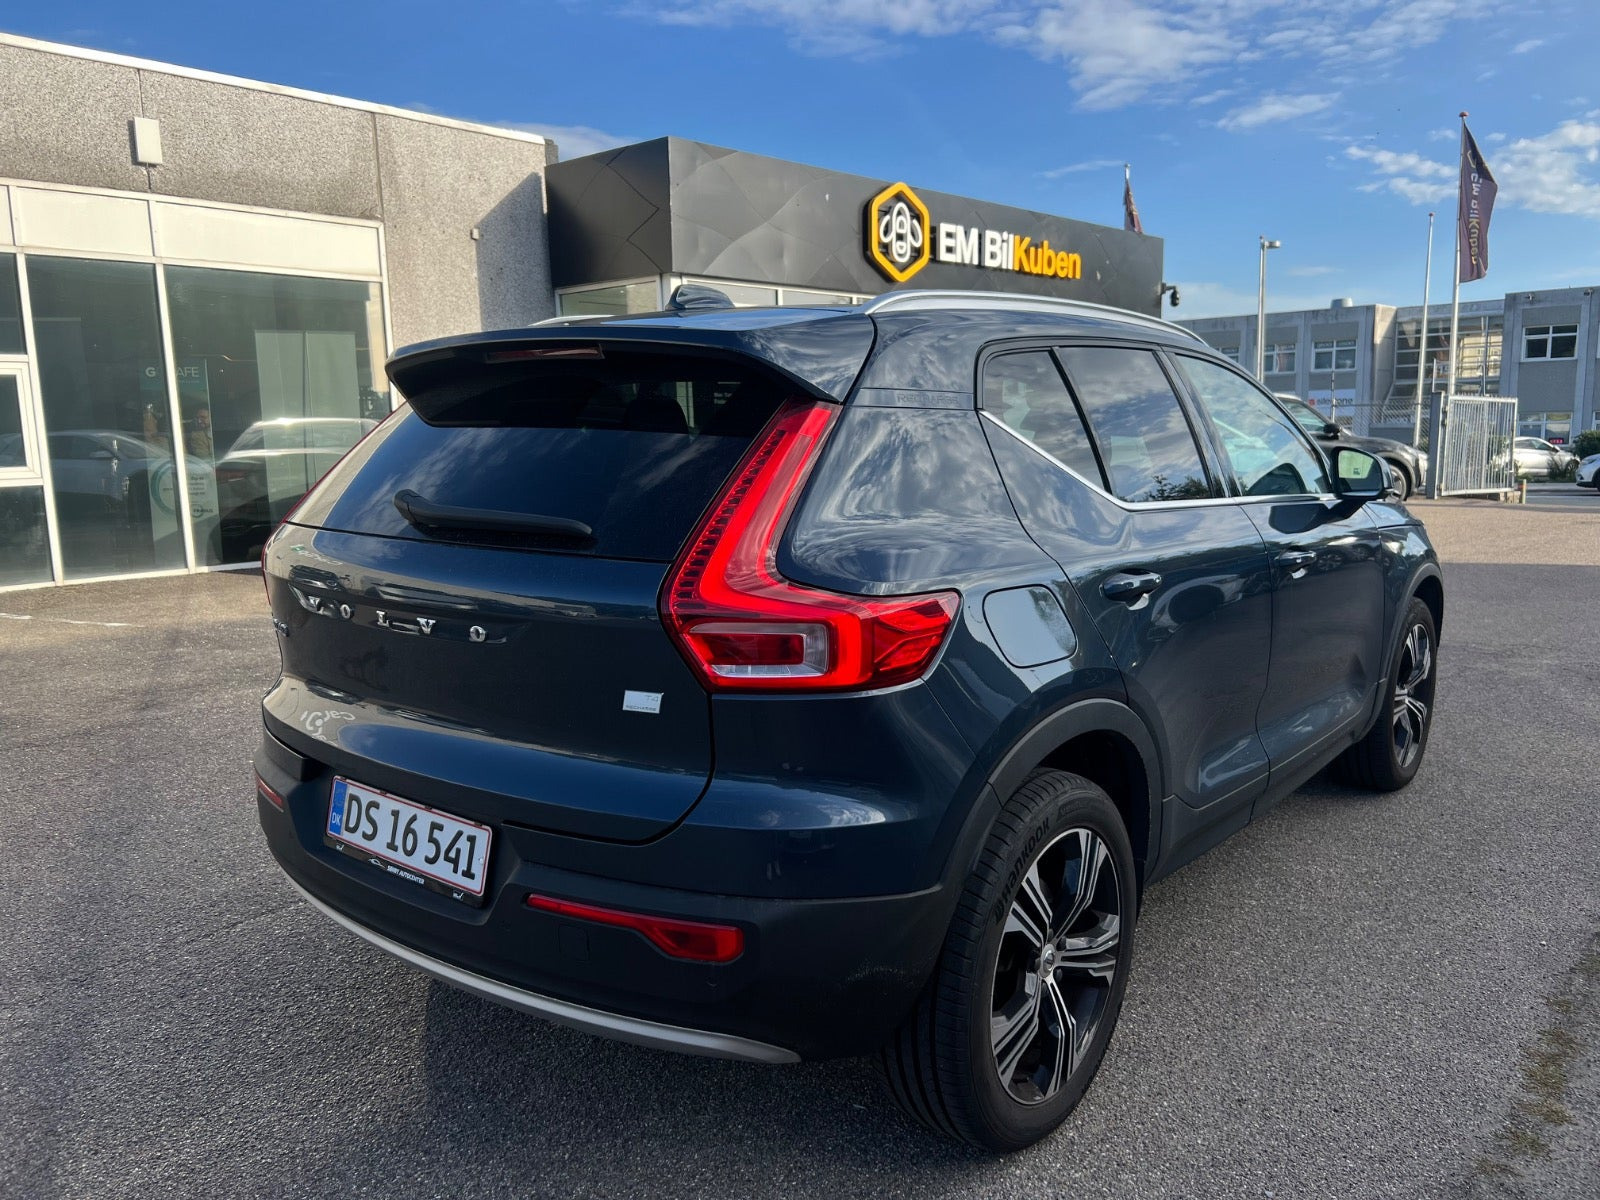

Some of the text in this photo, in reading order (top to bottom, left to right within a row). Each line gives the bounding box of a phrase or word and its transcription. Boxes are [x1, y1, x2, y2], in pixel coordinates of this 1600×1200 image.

[938, 222, 1081, 279] EM BilKuben
[308, 595, 487, 643] VOLVO
[331, 812, 342, 826] DK
[344, 793, 477, 881] DS 16 541
